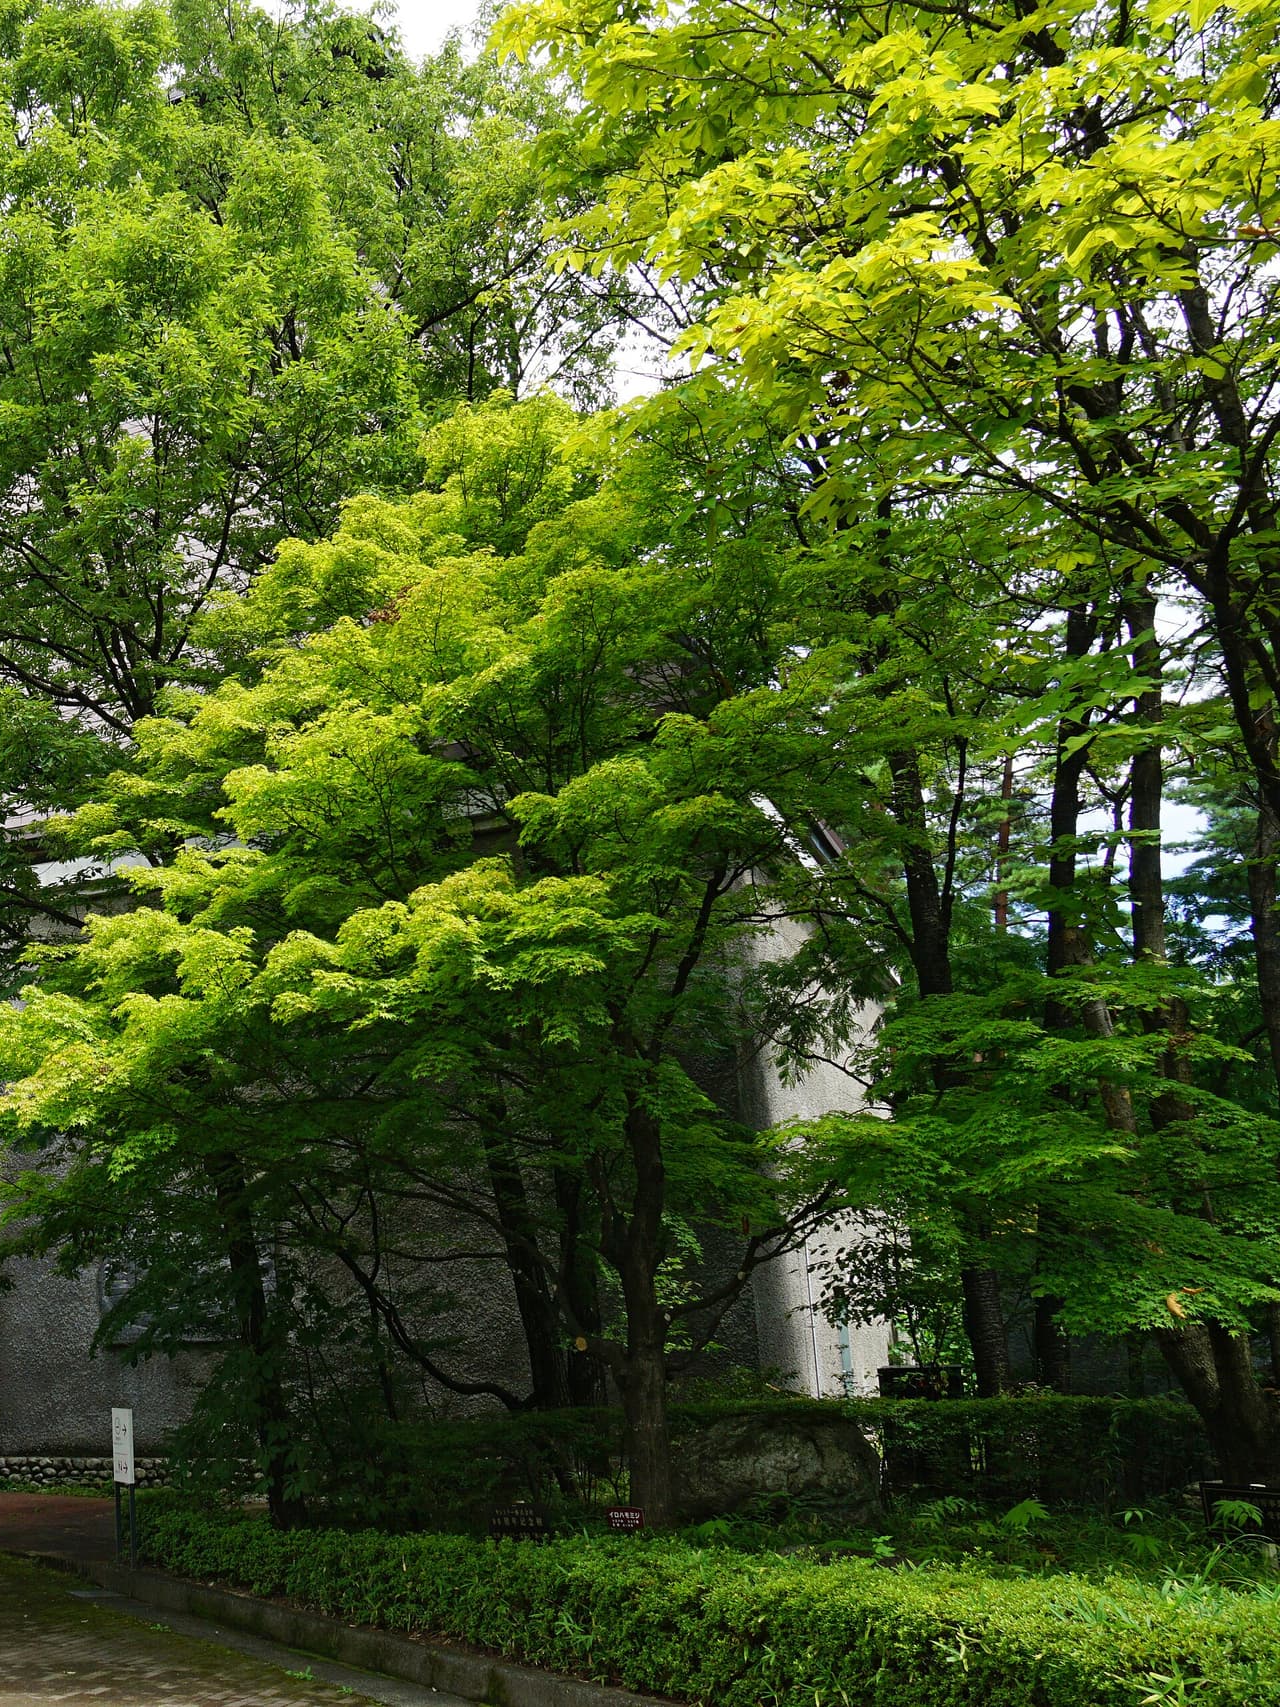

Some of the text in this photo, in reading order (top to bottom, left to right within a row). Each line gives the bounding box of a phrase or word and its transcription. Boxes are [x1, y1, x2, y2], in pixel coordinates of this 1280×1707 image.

[609, 1511, 640, 1519] イロハモミジ
